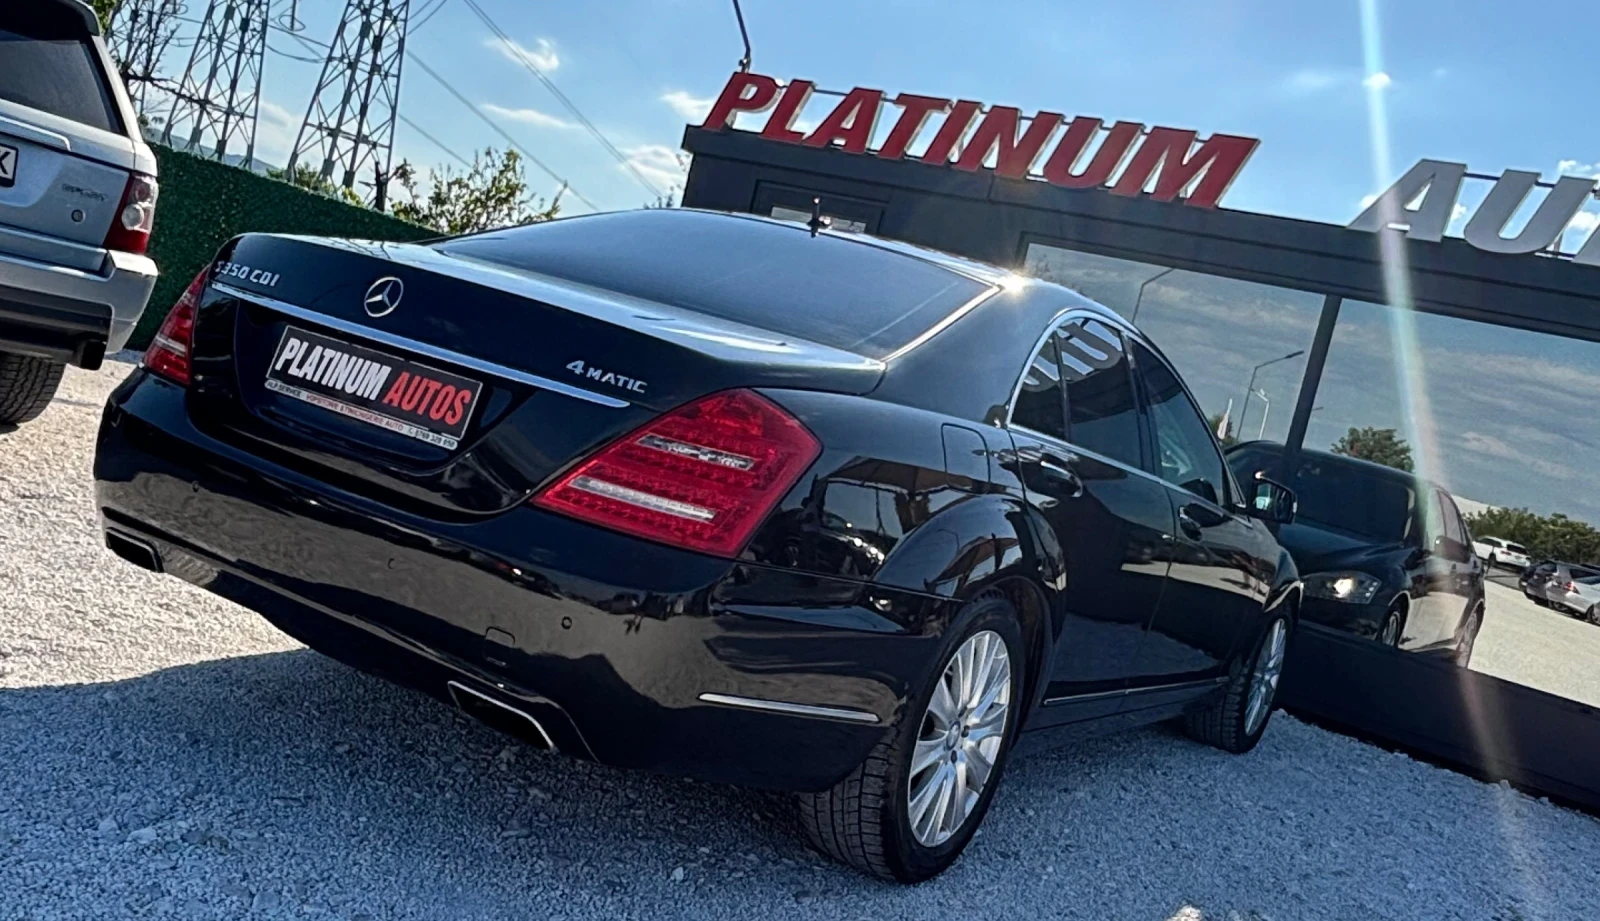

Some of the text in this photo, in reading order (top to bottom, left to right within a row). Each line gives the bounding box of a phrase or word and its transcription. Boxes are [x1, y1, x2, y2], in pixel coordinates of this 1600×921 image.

[703, 72, 1600, 268] PLATINUM AU
[215, 260, 280, 287] S350 CDI
[275, 337, 472, 426] PLATINUM AUTOS
[385, 420, 404, 432] AUTO
